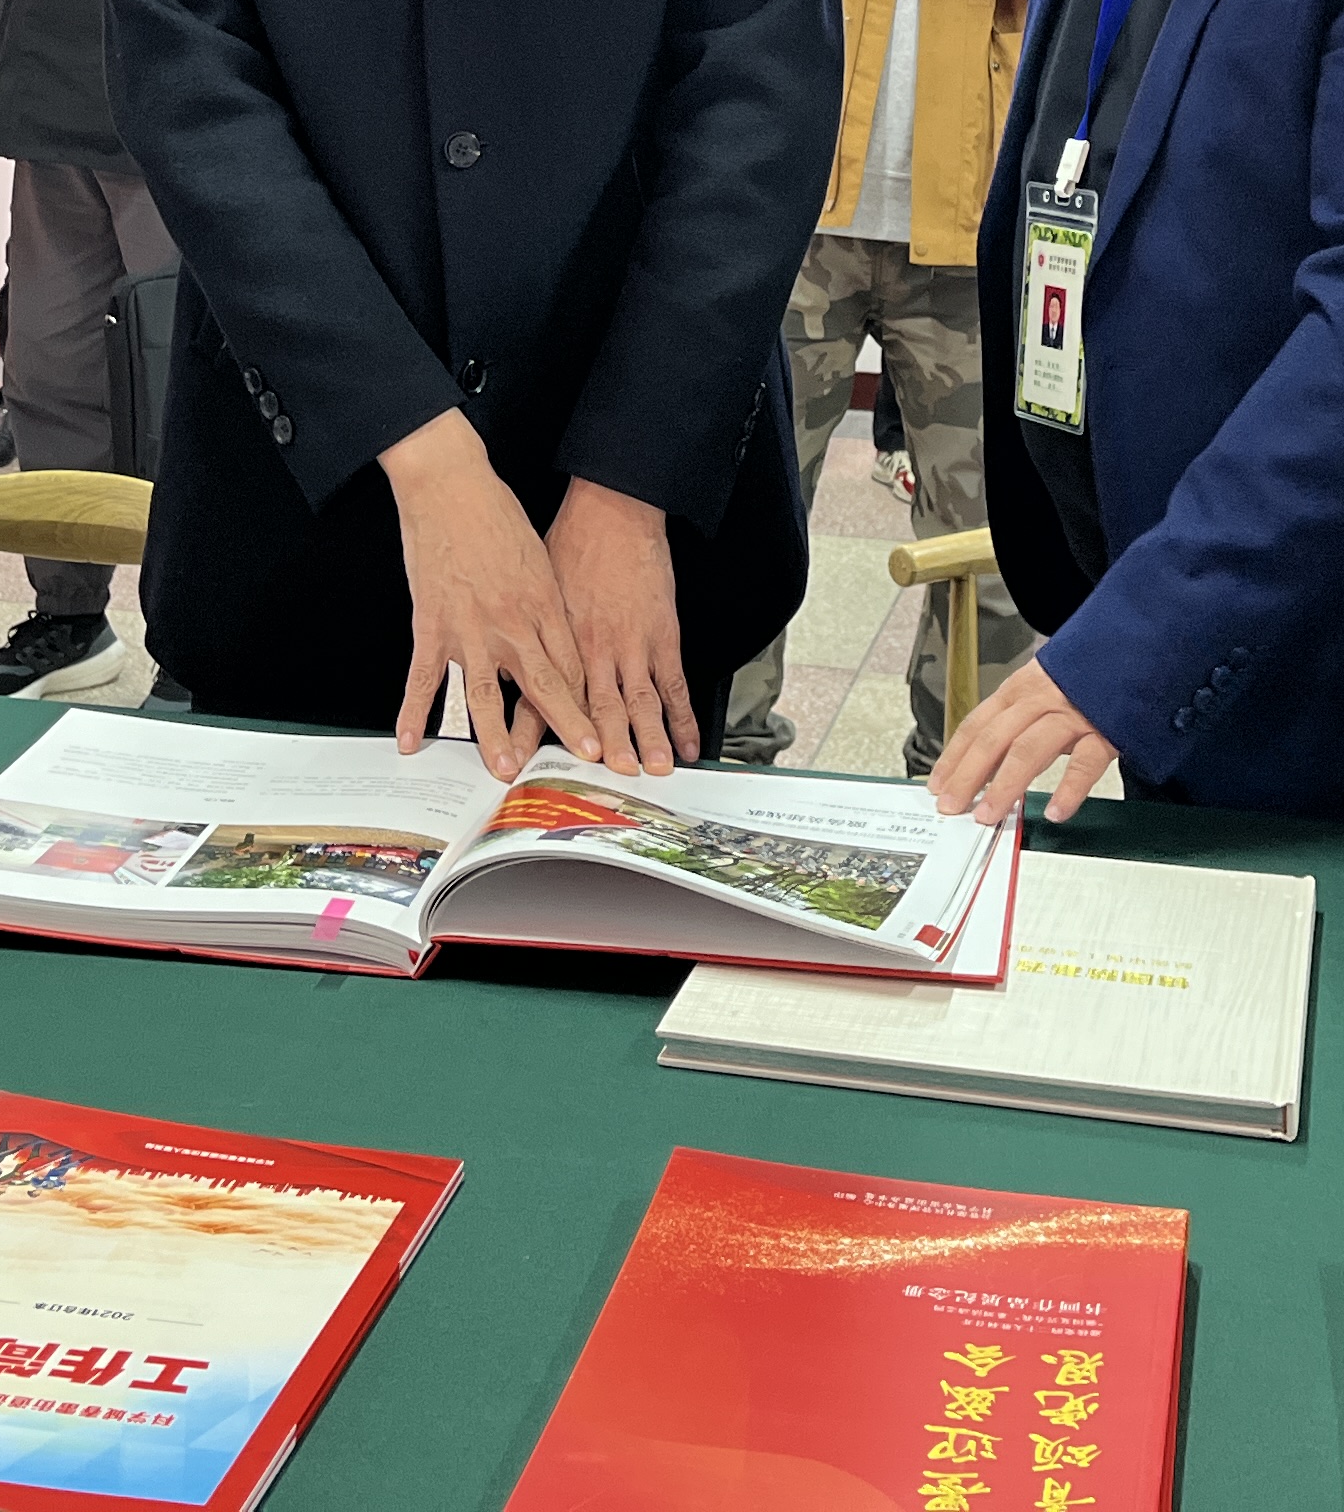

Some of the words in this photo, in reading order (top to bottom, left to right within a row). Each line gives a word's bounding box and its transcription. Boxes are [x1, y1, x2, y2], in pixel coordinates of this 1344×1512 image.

[32, 1301, 136, 1322] 2021年合订本
[903, 1284, 1107, 1316] 书画作品展纪念册
